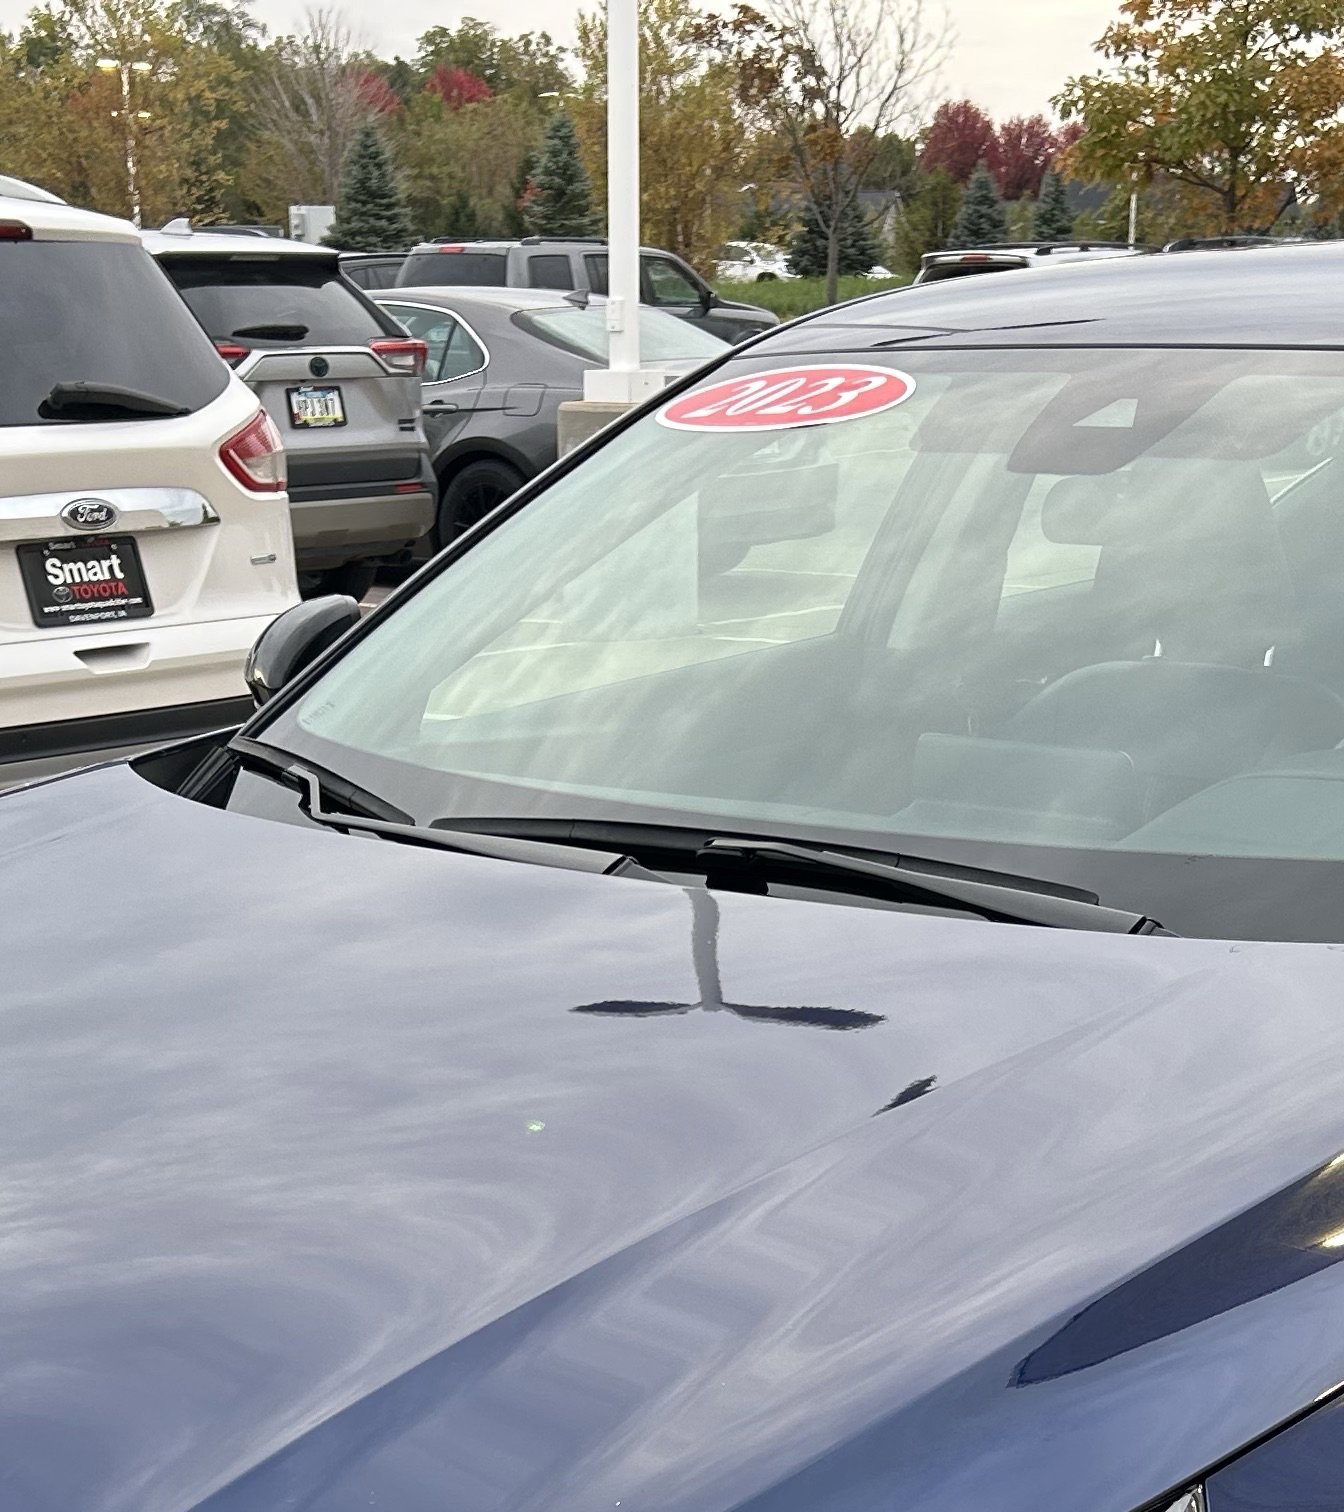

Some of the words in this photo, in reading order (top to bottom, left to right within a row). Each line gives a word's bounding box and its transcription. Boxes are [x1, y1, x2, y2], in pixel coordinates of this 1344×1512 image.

[680, 376, 887, 419] 2023
[76, 504, 108, 522] Ford
[45, 554, 124, 585] Smart
[70, 582, 128, 600] TOYOTA
